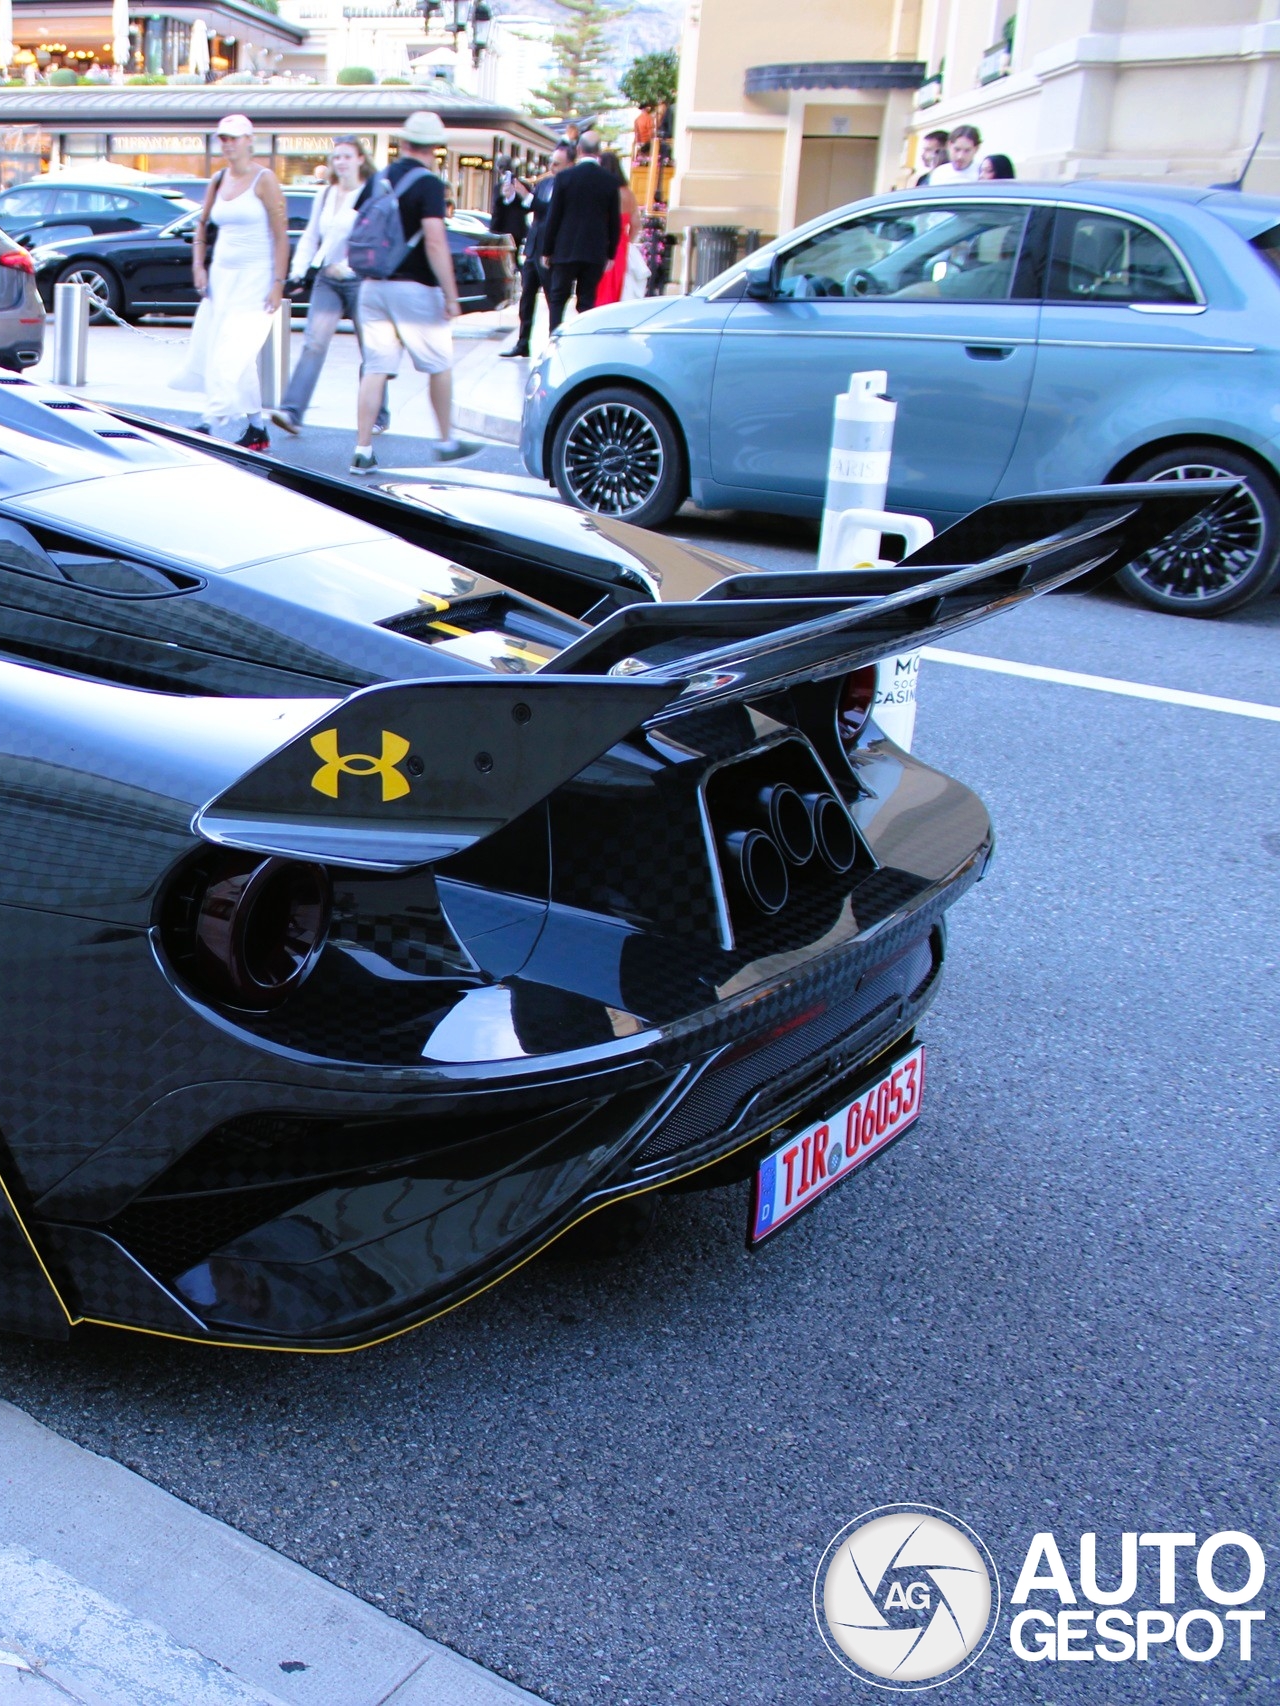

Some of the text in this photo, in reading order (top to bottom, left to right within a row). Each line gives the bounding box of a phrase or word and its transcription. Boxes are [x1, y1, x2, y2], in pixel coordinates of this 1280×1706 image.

[783, 1058, 918, 1206] TIR 06053
[761, 1203, 770, 1222] D
